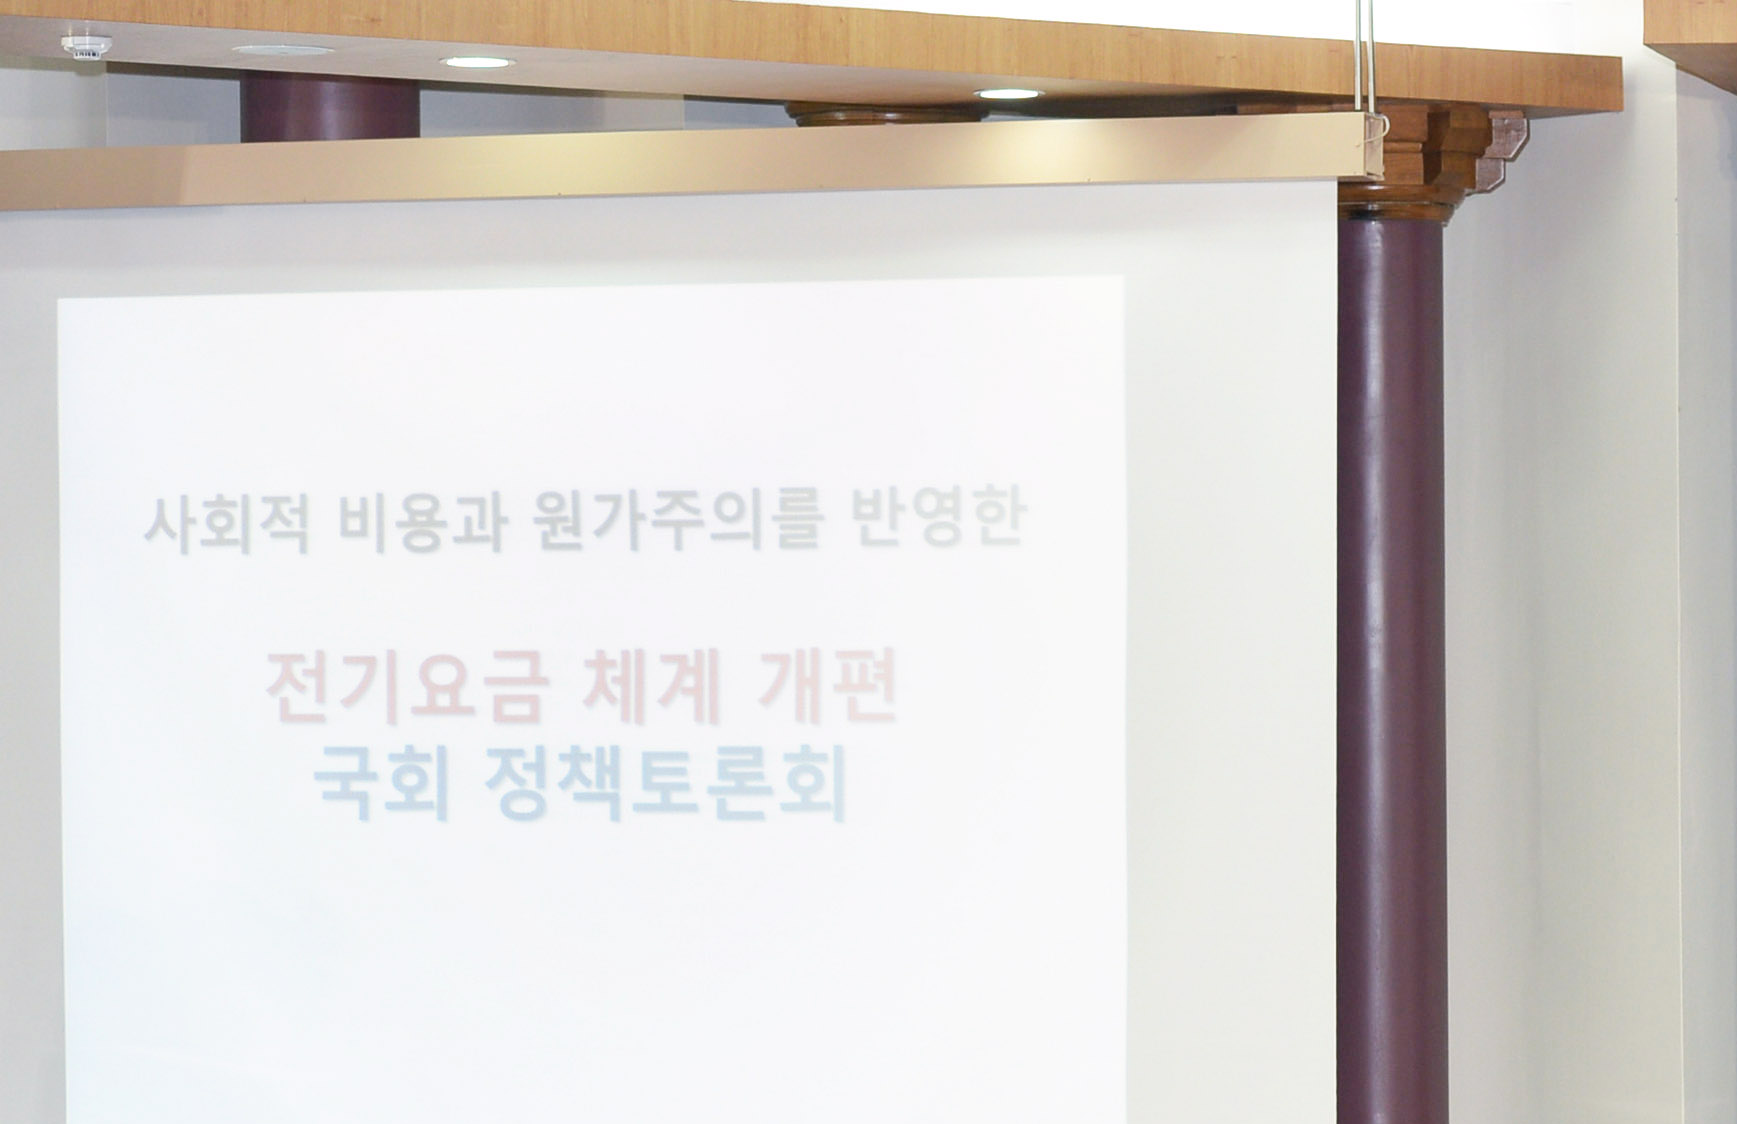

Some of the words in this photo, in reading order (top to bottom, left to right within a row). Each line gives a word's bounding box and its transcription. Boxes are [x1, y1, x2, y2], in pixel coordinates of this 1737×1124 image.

[142, 493, 310, 556] 사회적
[339, 490, 511, 555] 비용과
[531, 486, 826, 552] 원가주의를
[850, 484, 1029, 549] 반영한
[265, 648, 551, 728] 전기요금
[582, 648, 722, 727] 체계
[756, 646, 898, 726] 개편
[312, 743, 449, 823] 국회
[483, 743, 848, 824] 정책토론회
